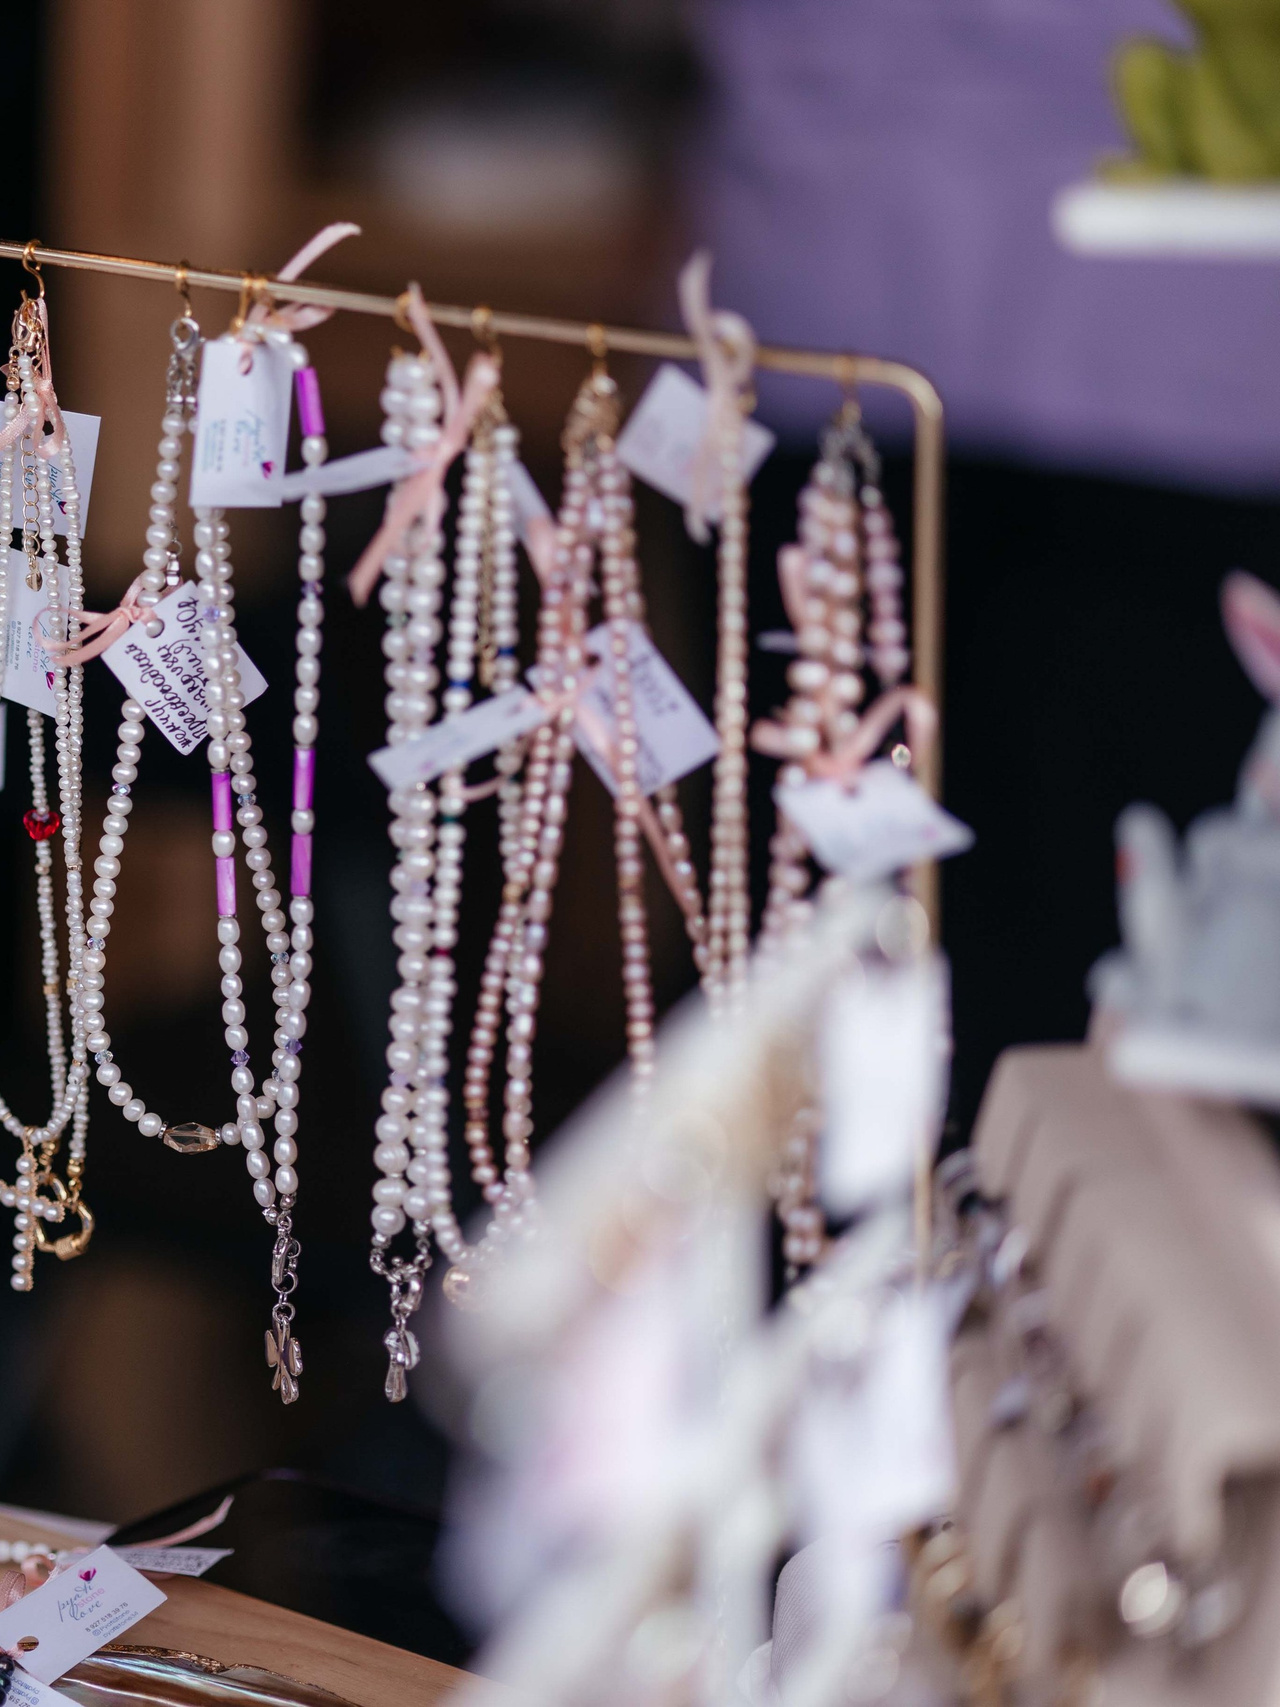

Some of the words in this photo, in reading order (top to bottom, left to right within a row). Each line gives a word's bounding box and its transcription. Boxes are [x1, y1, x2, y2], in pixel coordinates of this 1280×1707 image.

[77, 1588, 105, 1608] stone
[69, 1601, 102, 1621] love
[89, 1619, 101, 1630] 927
[101, 1612, 113, 1623] 518
[111, 1607, 120, 1615] 39
[8, 1695, 20, 1704] 518
